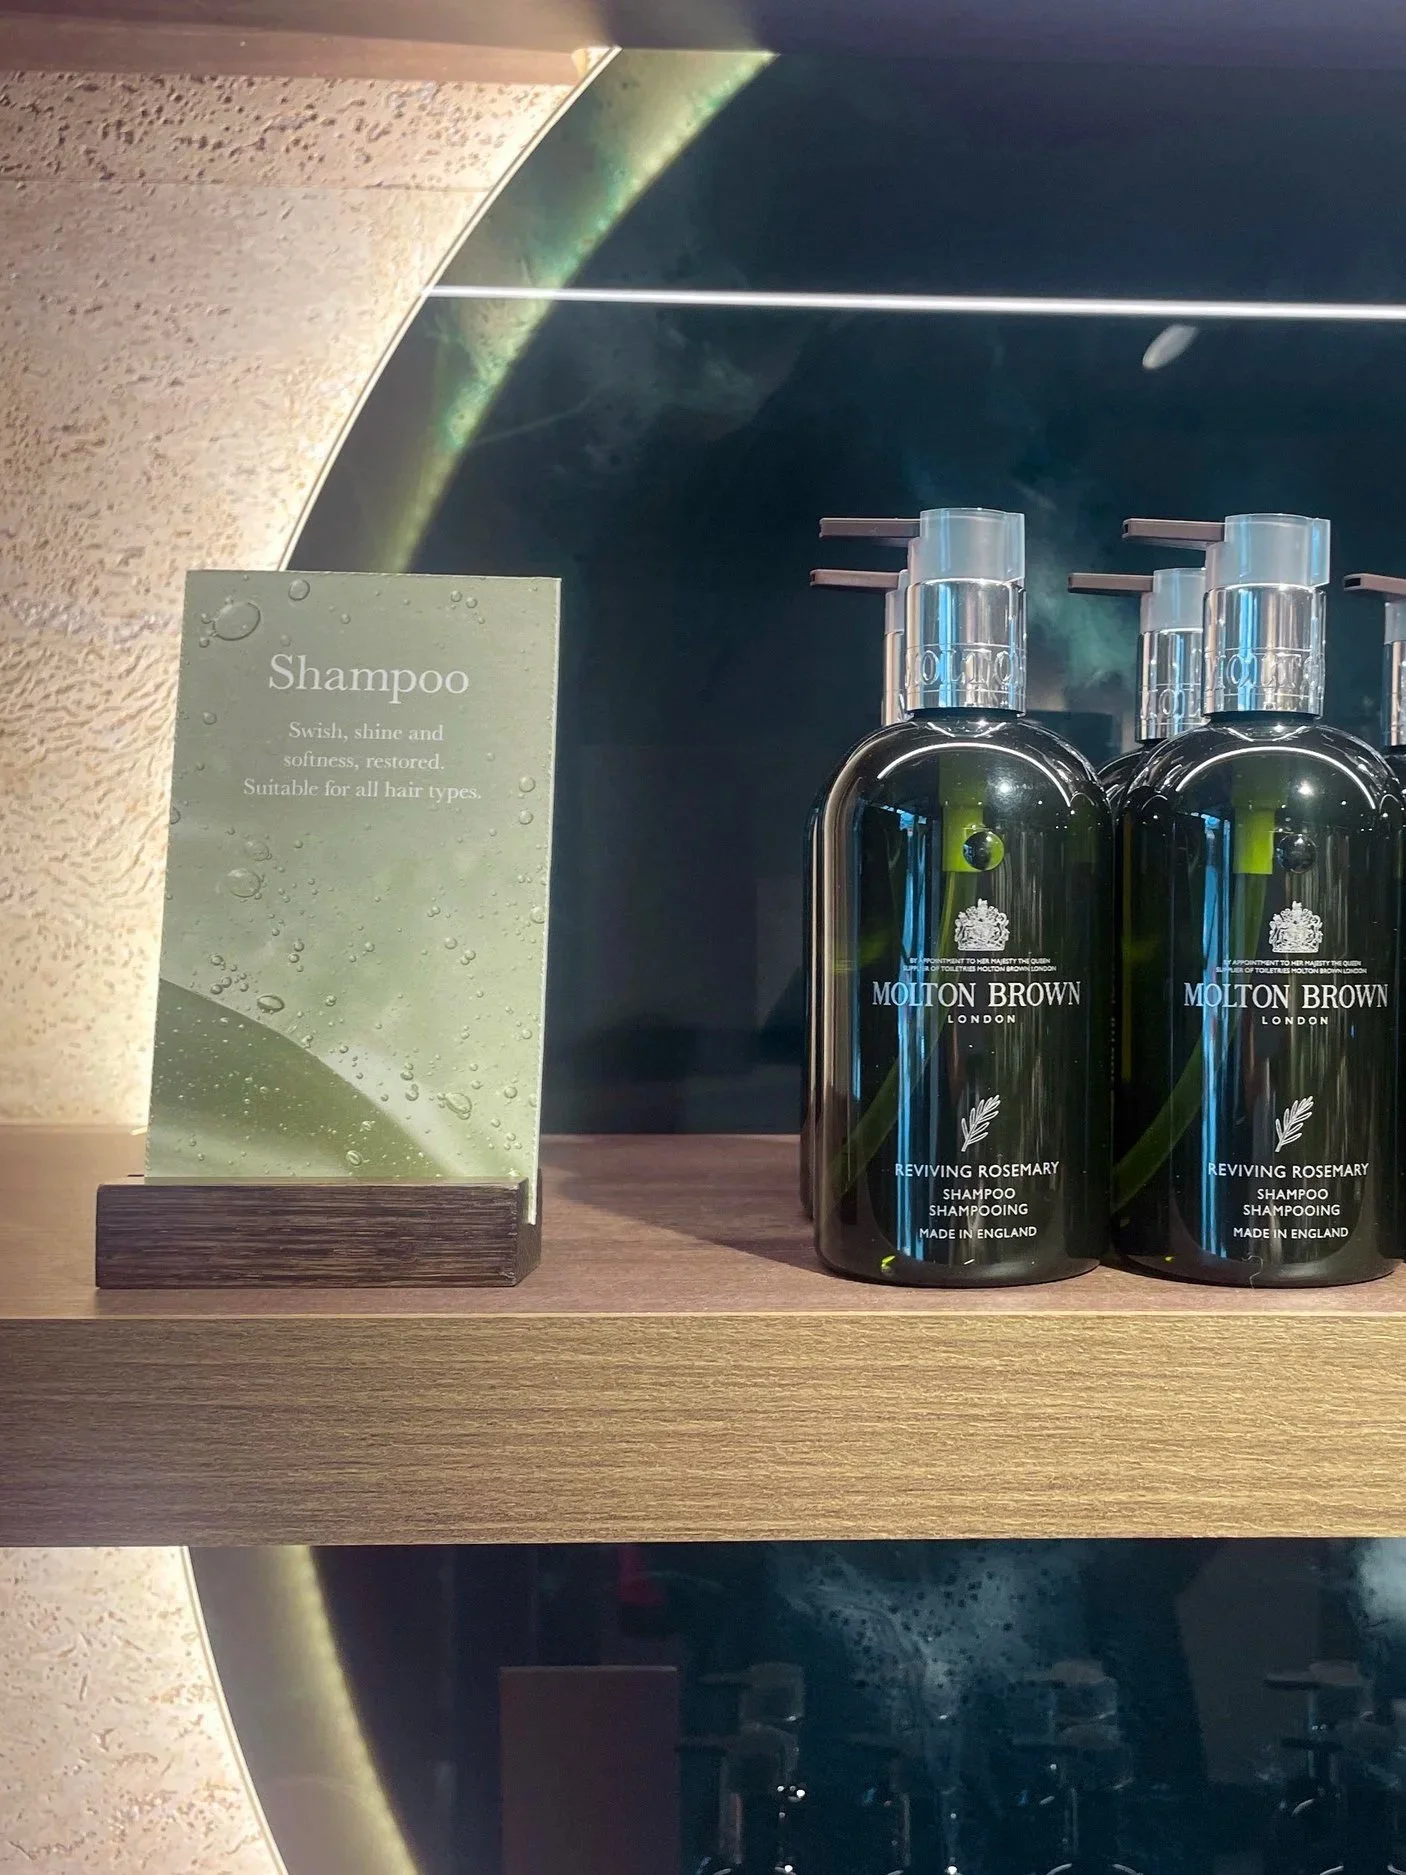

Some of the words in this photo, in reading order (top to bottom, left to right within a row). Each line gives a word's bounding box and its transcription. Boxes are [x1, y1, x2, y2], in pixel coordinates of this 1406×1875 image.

[268, 653, 470, 704] Shampoo
[288, 721, 349, 743] Swish,
[354, 723, 402, 740] shine
[408, 724, 444, 741] and
[283, 751, 360, 771] softness,
[366, 753, 445, 770] restored.
[243, 778, 318, 796] Suitable
[324, 780, 350, 797] for
[356, 780, 378, 798] all
[384, 781, 423, 799] hair
[428, 783, 482, 804] types.
[872, 981, 976, 1007] MOLTON
[988, 980, 1081, 1007] BROWN
[1183, 982, 1290, 1009] MOLTON
[1302, 983, 1389, 1009] BROWN
[947, 1014, 1016, 1024] LONDON
[1261, 1016, 1329, 1025] LONDON
[895, 1163, 972, 1178] REVIVING
[978, 1161, 1060, 1178] ROSEMARY
[1208, 1163, 1286, 1179] REVIVING
[1292, 1162, 1370, 1178] ROSEMARY
[943, 1188, 1016, 1200] SHAMPOO
[1257, 1188, 1329, 1201] SHAMPOO
[929, 1203, 1029, 1217] SHAMPOOING
[1243, 1204, 1341, 1217] SHAMPOOING
[919, 1227, 956, 1240] MADE
[959, 1229, 973, 1239] IN
[977, 1226, 1038, 1239] ENGLAND
[1233, 1227, 1270, 1239] MADE
[1273, 1228, 1287, 1239] IN
[1291, 1227, 1349, 1239] ENGLAND
